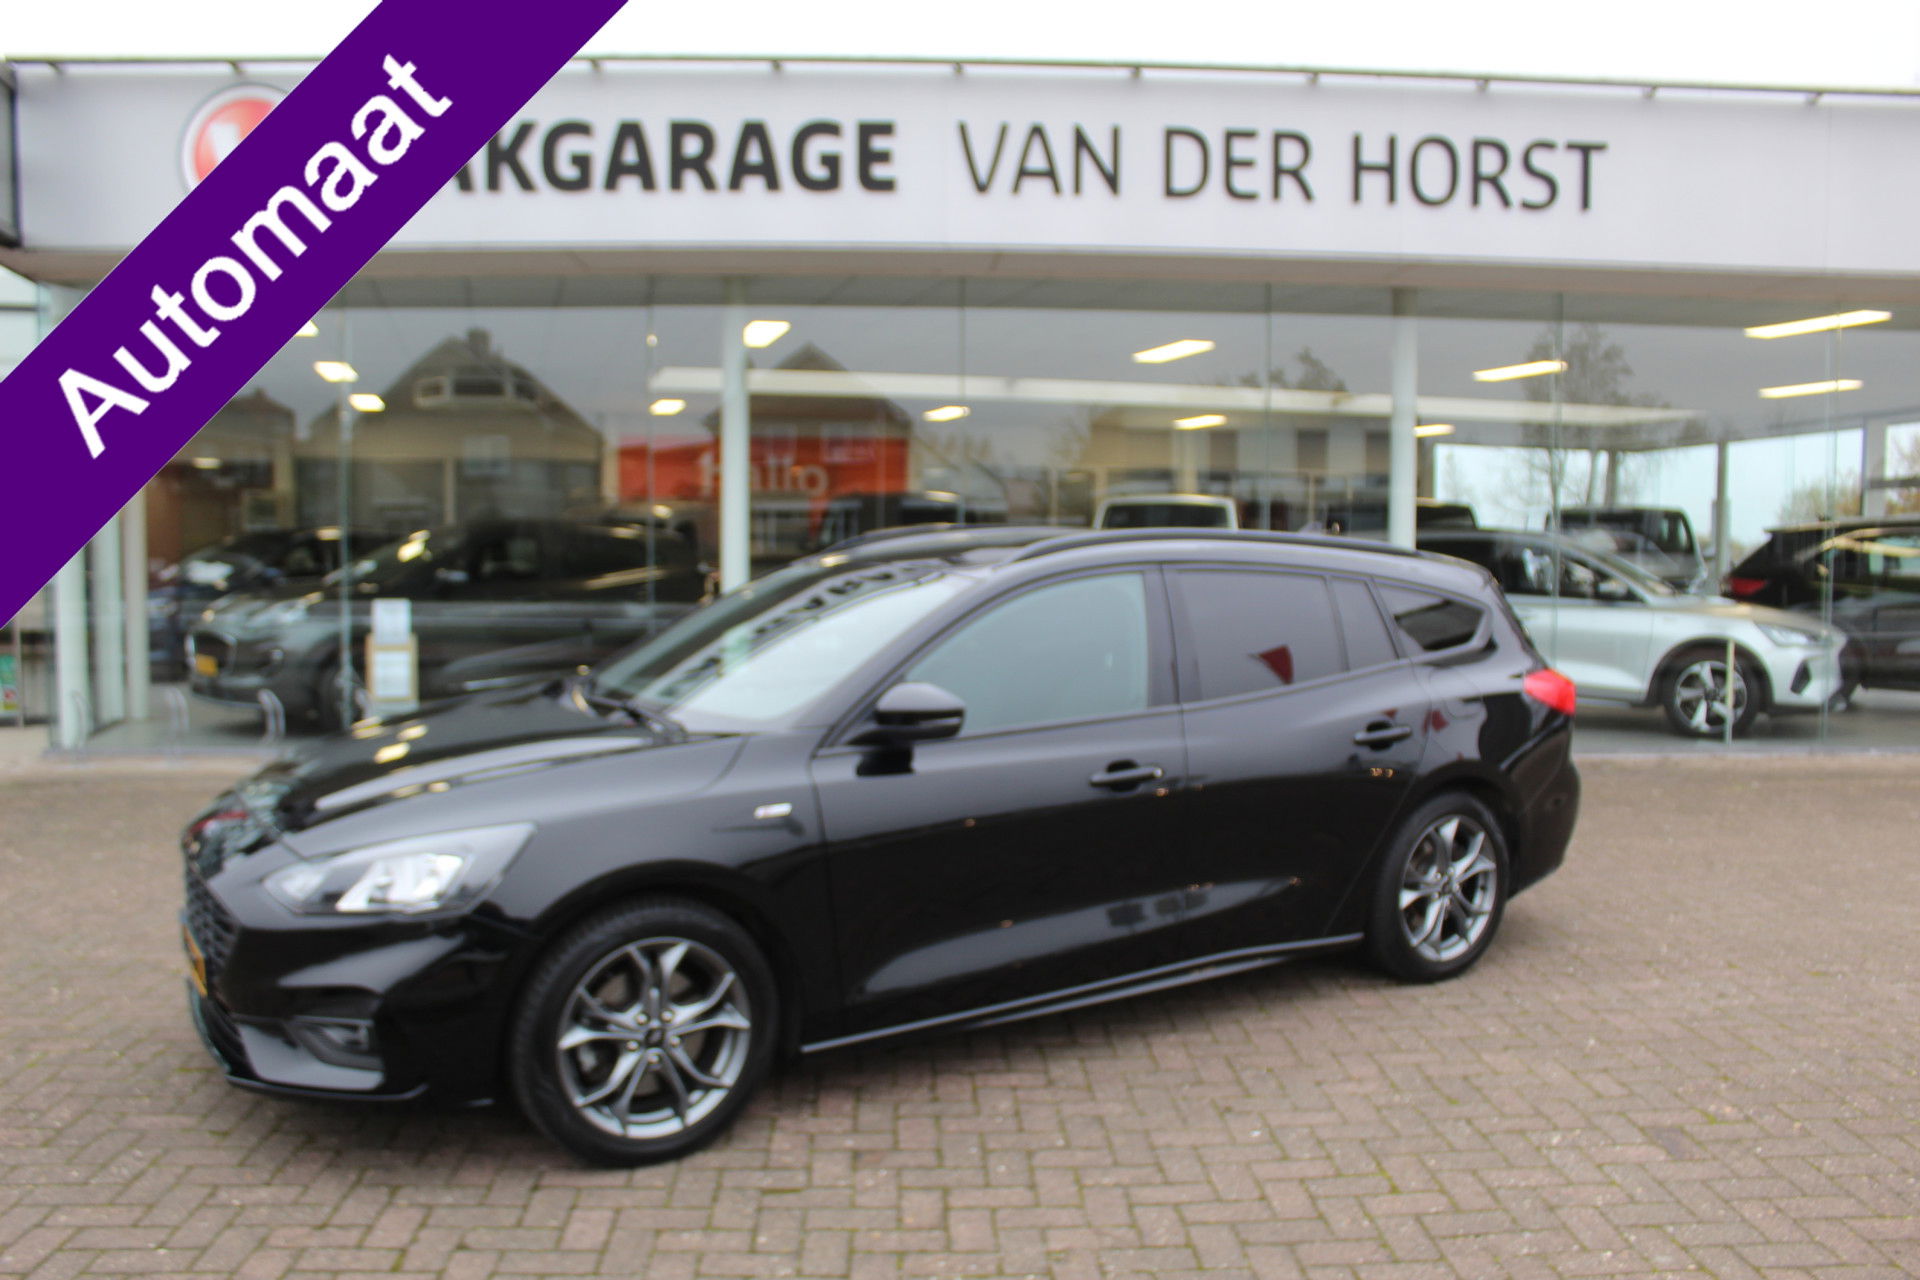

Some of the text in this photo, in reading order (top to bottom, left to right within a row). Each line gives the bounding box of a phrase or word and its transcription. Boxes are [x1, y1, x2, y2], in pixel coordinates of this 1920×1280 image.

[958, 122, 1121, 196] VAN
[1164, 127, 1315, 202] DER
[1352, 133, 1608, 211] HORST
